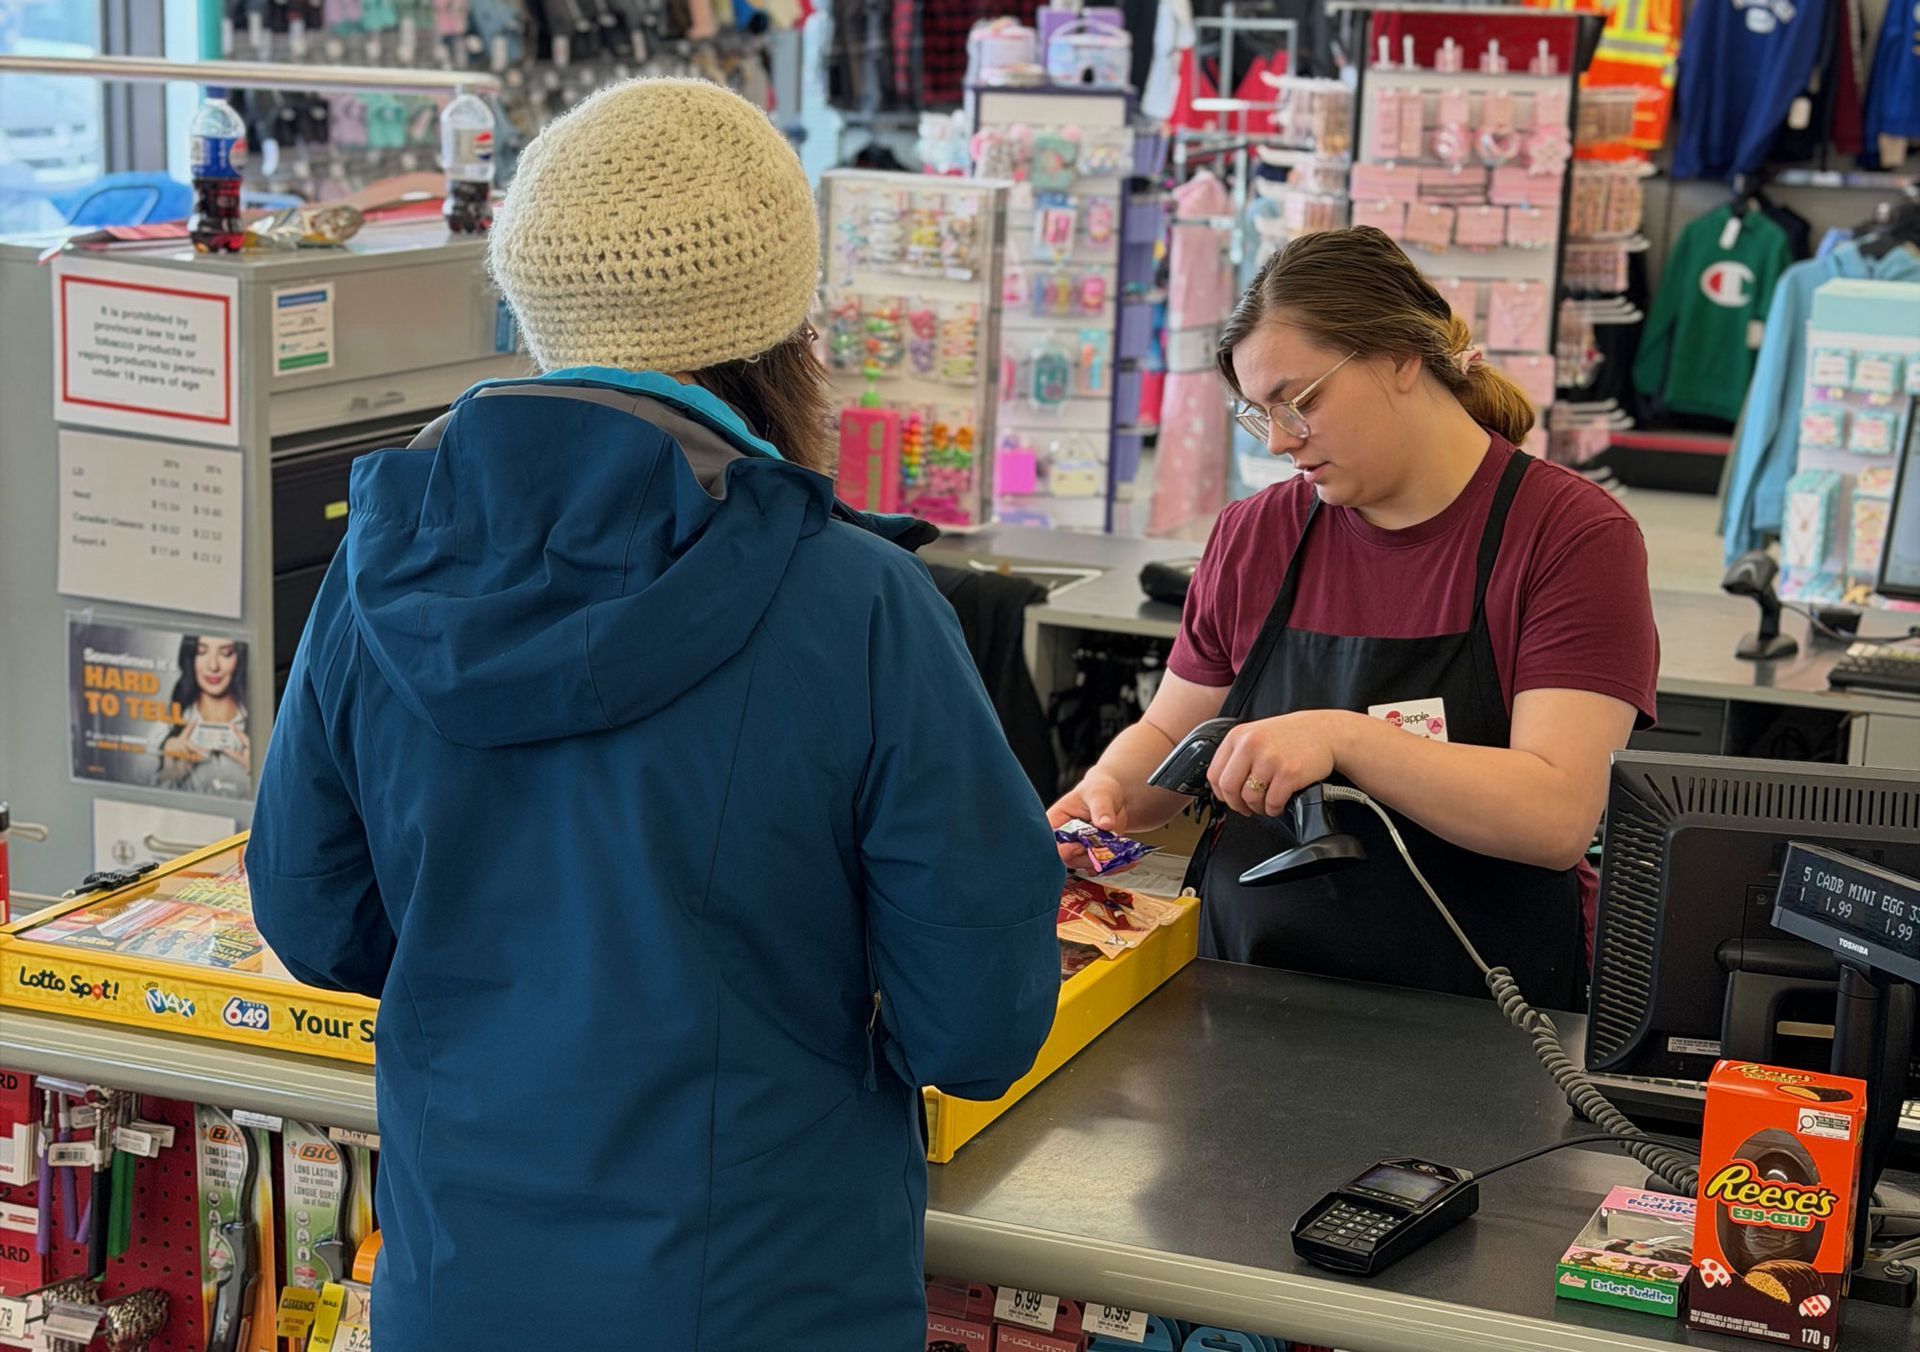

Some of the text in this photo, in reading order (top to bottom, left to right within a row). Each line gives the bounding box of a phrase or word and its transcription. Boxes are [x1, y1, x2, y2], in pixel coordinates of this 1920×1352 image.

[110, 307, 118, 317] is
[122, 309, 173, 325] prohibited
[176, 315, 189, 328] by
[93, 321, 197, 342] provincial law to sell
[94, 336, 196, 358] tobacco products or
[78, 350, 216, 377] vaping products to persons
[92, 366, 200, 391] under 18 years of age
[72, 512, 109, 525] Canadian
[84, 647, 154, 670] Sometimes
[85, 664, 161, 695] HARD
[85, 690, 186, 726] TO TELL
[1404, 711, 1430, 725] apple
[1803, 866, 1812, 882] 5
[1816, 872, 1844, 894] CADB
[1848, 882, 1877, 907] MINI
[1881, 895, 1905, 917] EGG
[1800, 886, 1913, 941] 1 1.99 1.99
[1839, 938, 1869, 956] TOSHIBA
[19, 965, 120, 1001] Lotto Spot!
[145, 988, 196, 1018] MAX
[288, 1007, 354, 1039] Your
[303, 1146, 338, 1161] BIC
[1705, 1164, 1838, 1218] Reese's
[1592, 1280, 1628, 1296] Easter
[1629, 1287, 1673, 1304] Buddies
[1801, 1328, 1830, 1350] 170 g
